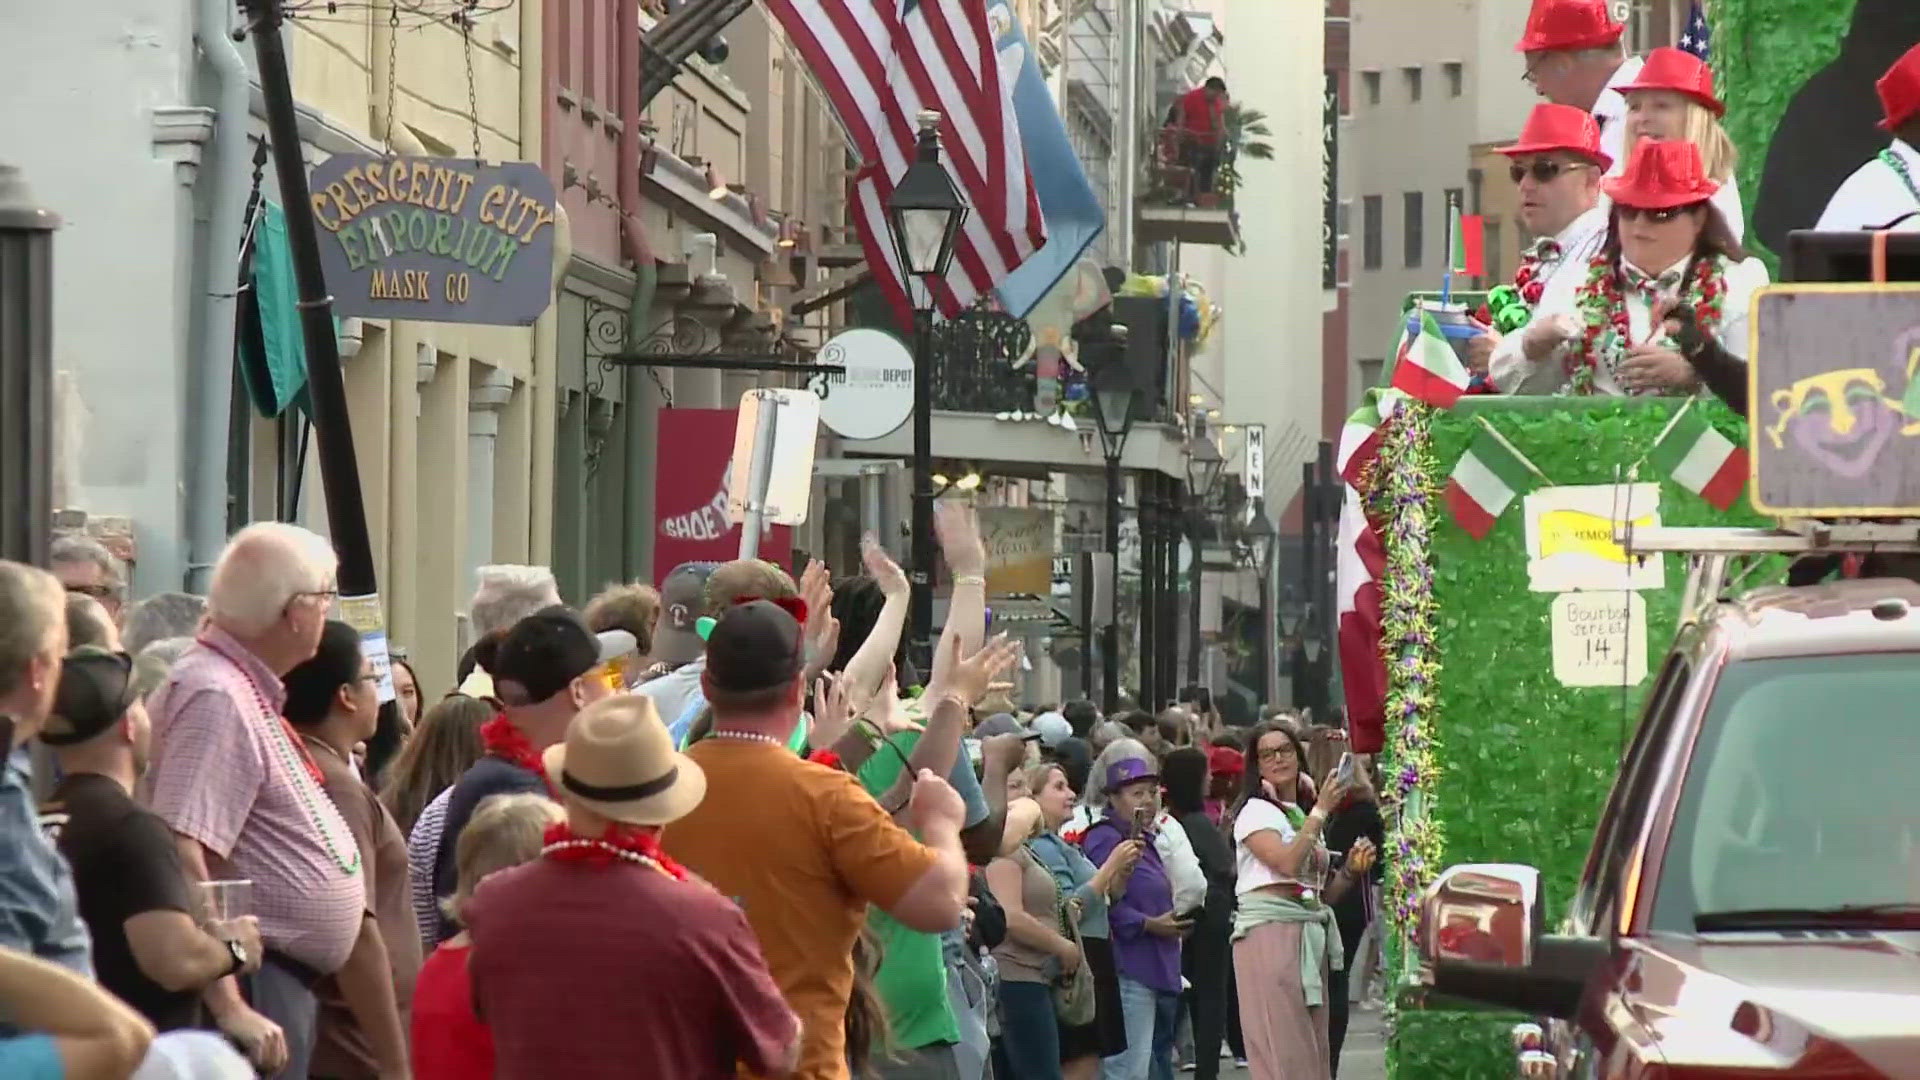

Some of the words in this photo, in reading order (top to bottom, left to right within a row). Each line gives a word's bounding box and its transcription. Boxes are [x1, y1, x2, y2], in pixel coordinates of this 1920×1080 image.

[311, 160, 474, 232] CRESCENT
[479, 184, 553, 243] CITY
[337, 208, 518, 282] EMPORIUM
[370, 268, 430, 300] MASK
[446, 272, 469, 302] CO
[882, 368, 912, 382] DEPOT
[1249, 430, 1261, 490] MEN
[665, 504, 720, 541] SHOE
[1586, 638, 1611, 661] 14
